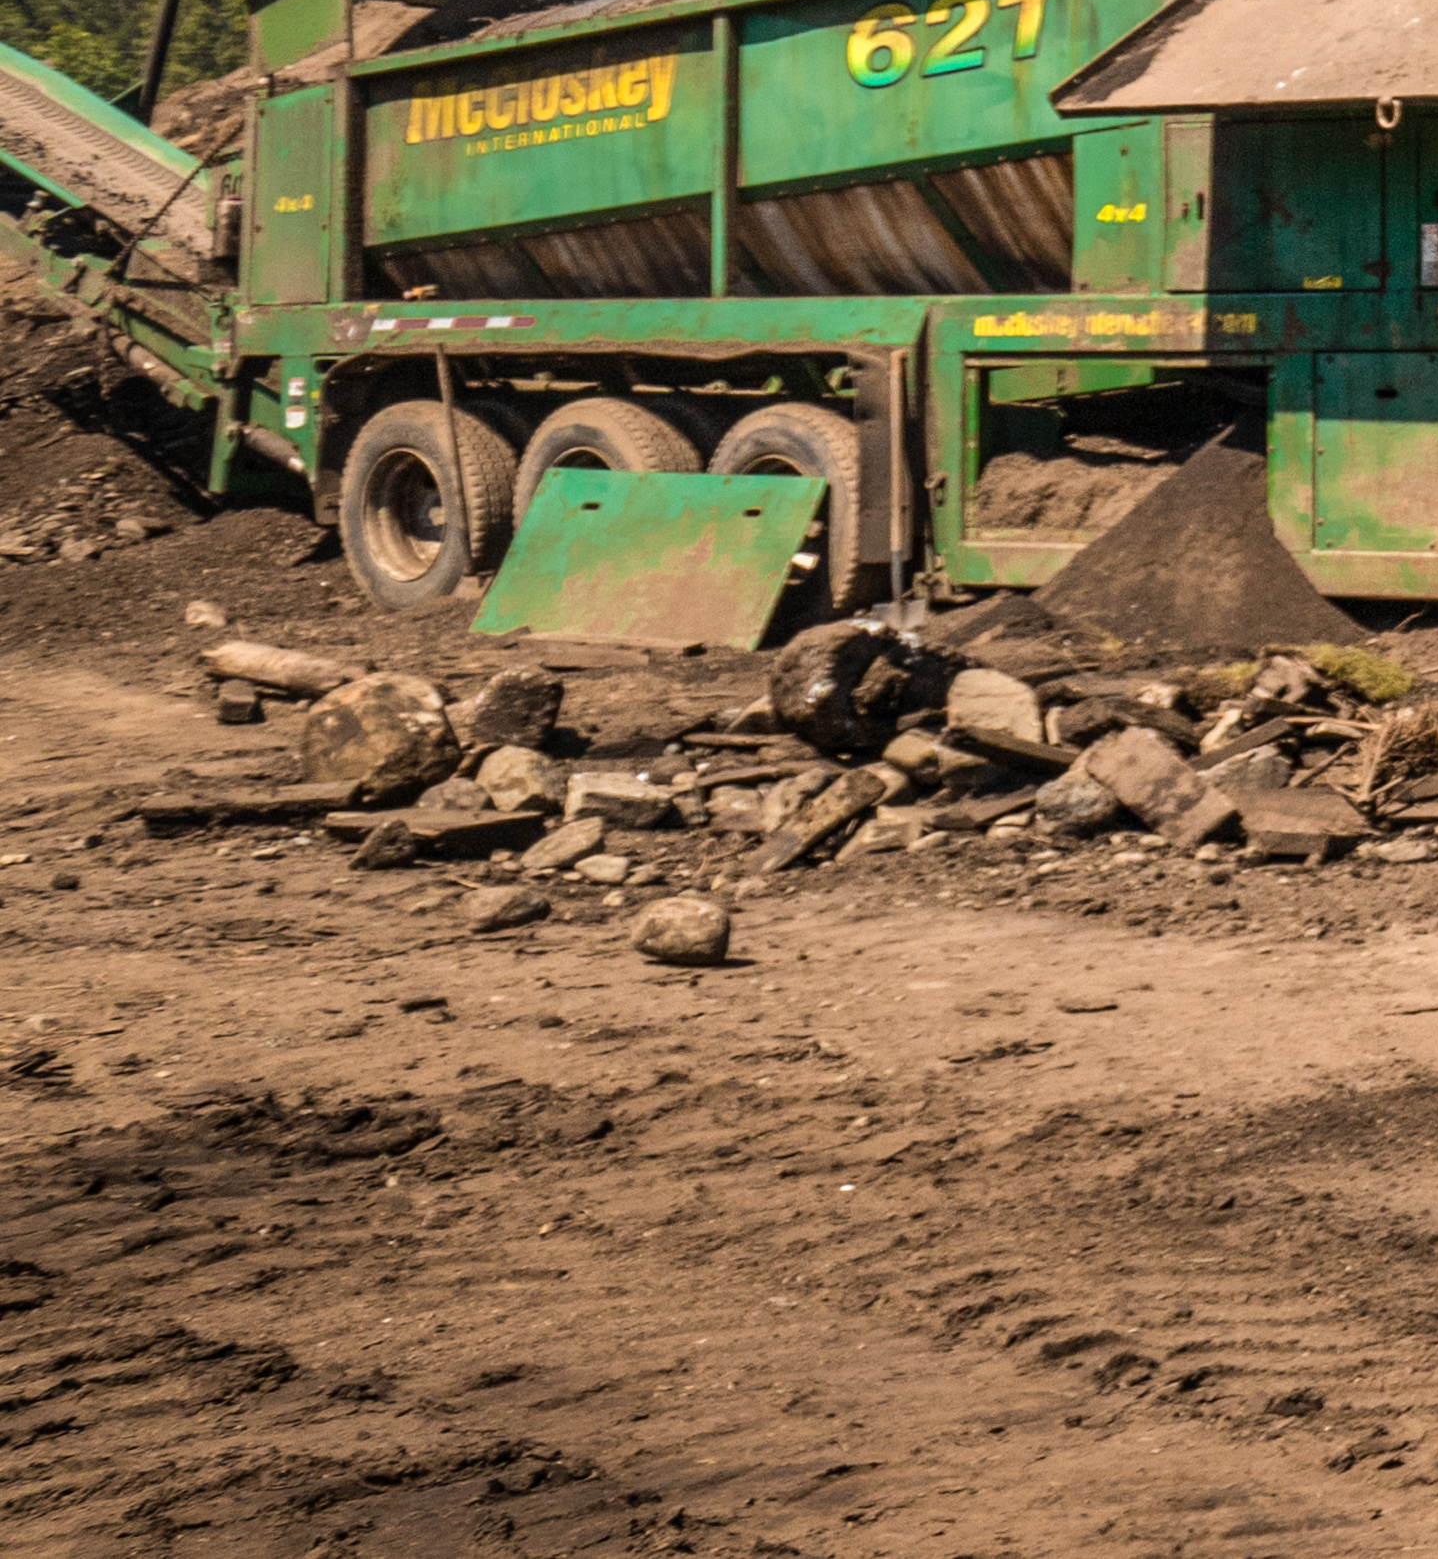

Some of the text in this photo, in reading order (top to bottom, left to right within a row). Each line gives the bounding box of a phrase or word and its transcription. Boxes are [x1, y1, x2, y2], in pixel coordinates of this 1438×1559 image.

[406, 46, 678, 144] McCloskey
[466, 111, 647, 156] INTERNATIONAL
[1096, 203, 1147, 223] 4x4
